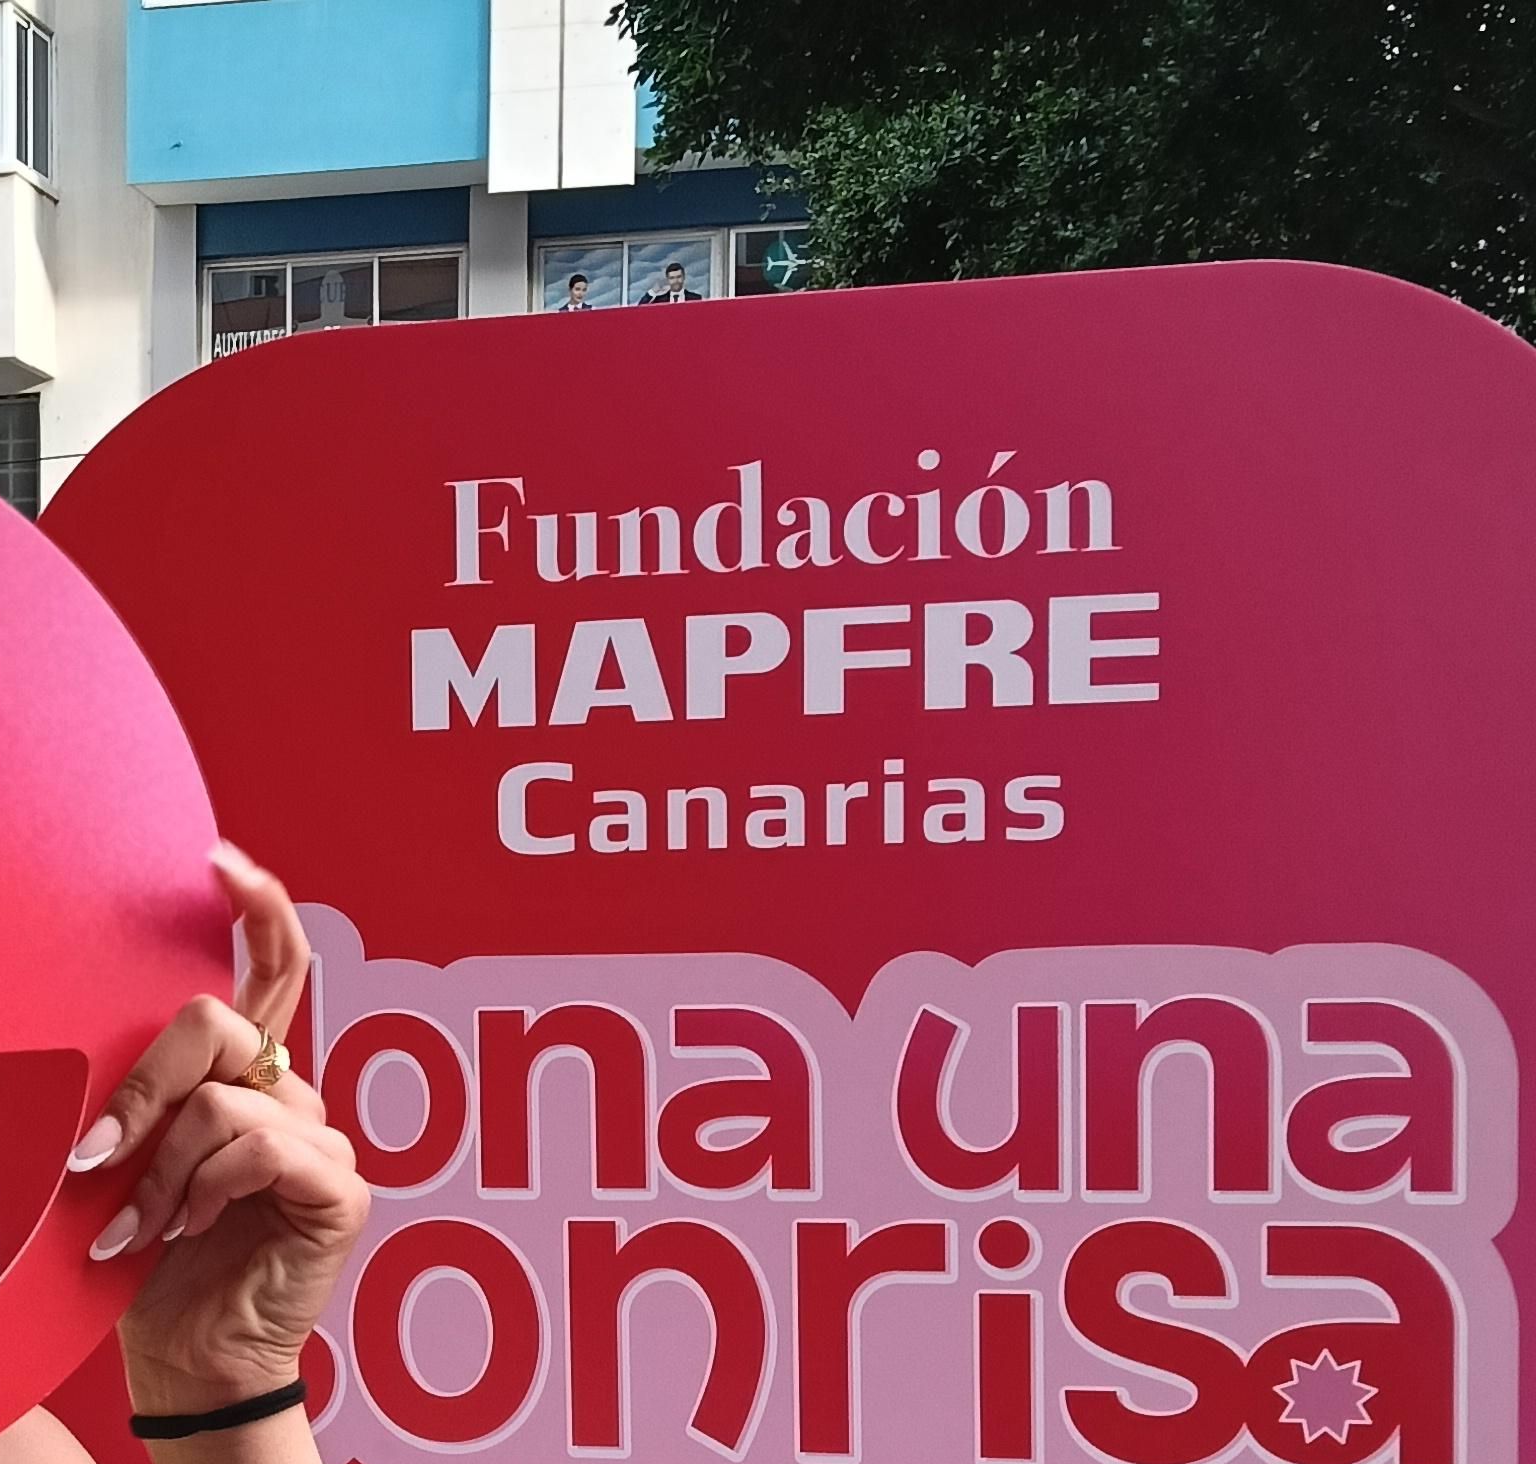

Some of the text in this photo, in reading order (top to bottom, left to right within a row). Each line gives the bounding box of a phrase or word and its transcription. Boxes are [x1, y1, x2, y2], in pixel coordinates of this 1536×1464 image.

[443, 450, 1122, 587] Fundación
[410, 592, 1160, 732] MAPFRE
[496, 759, 1065, 855] Canarias
[891, 995, 1467, 1205] una
